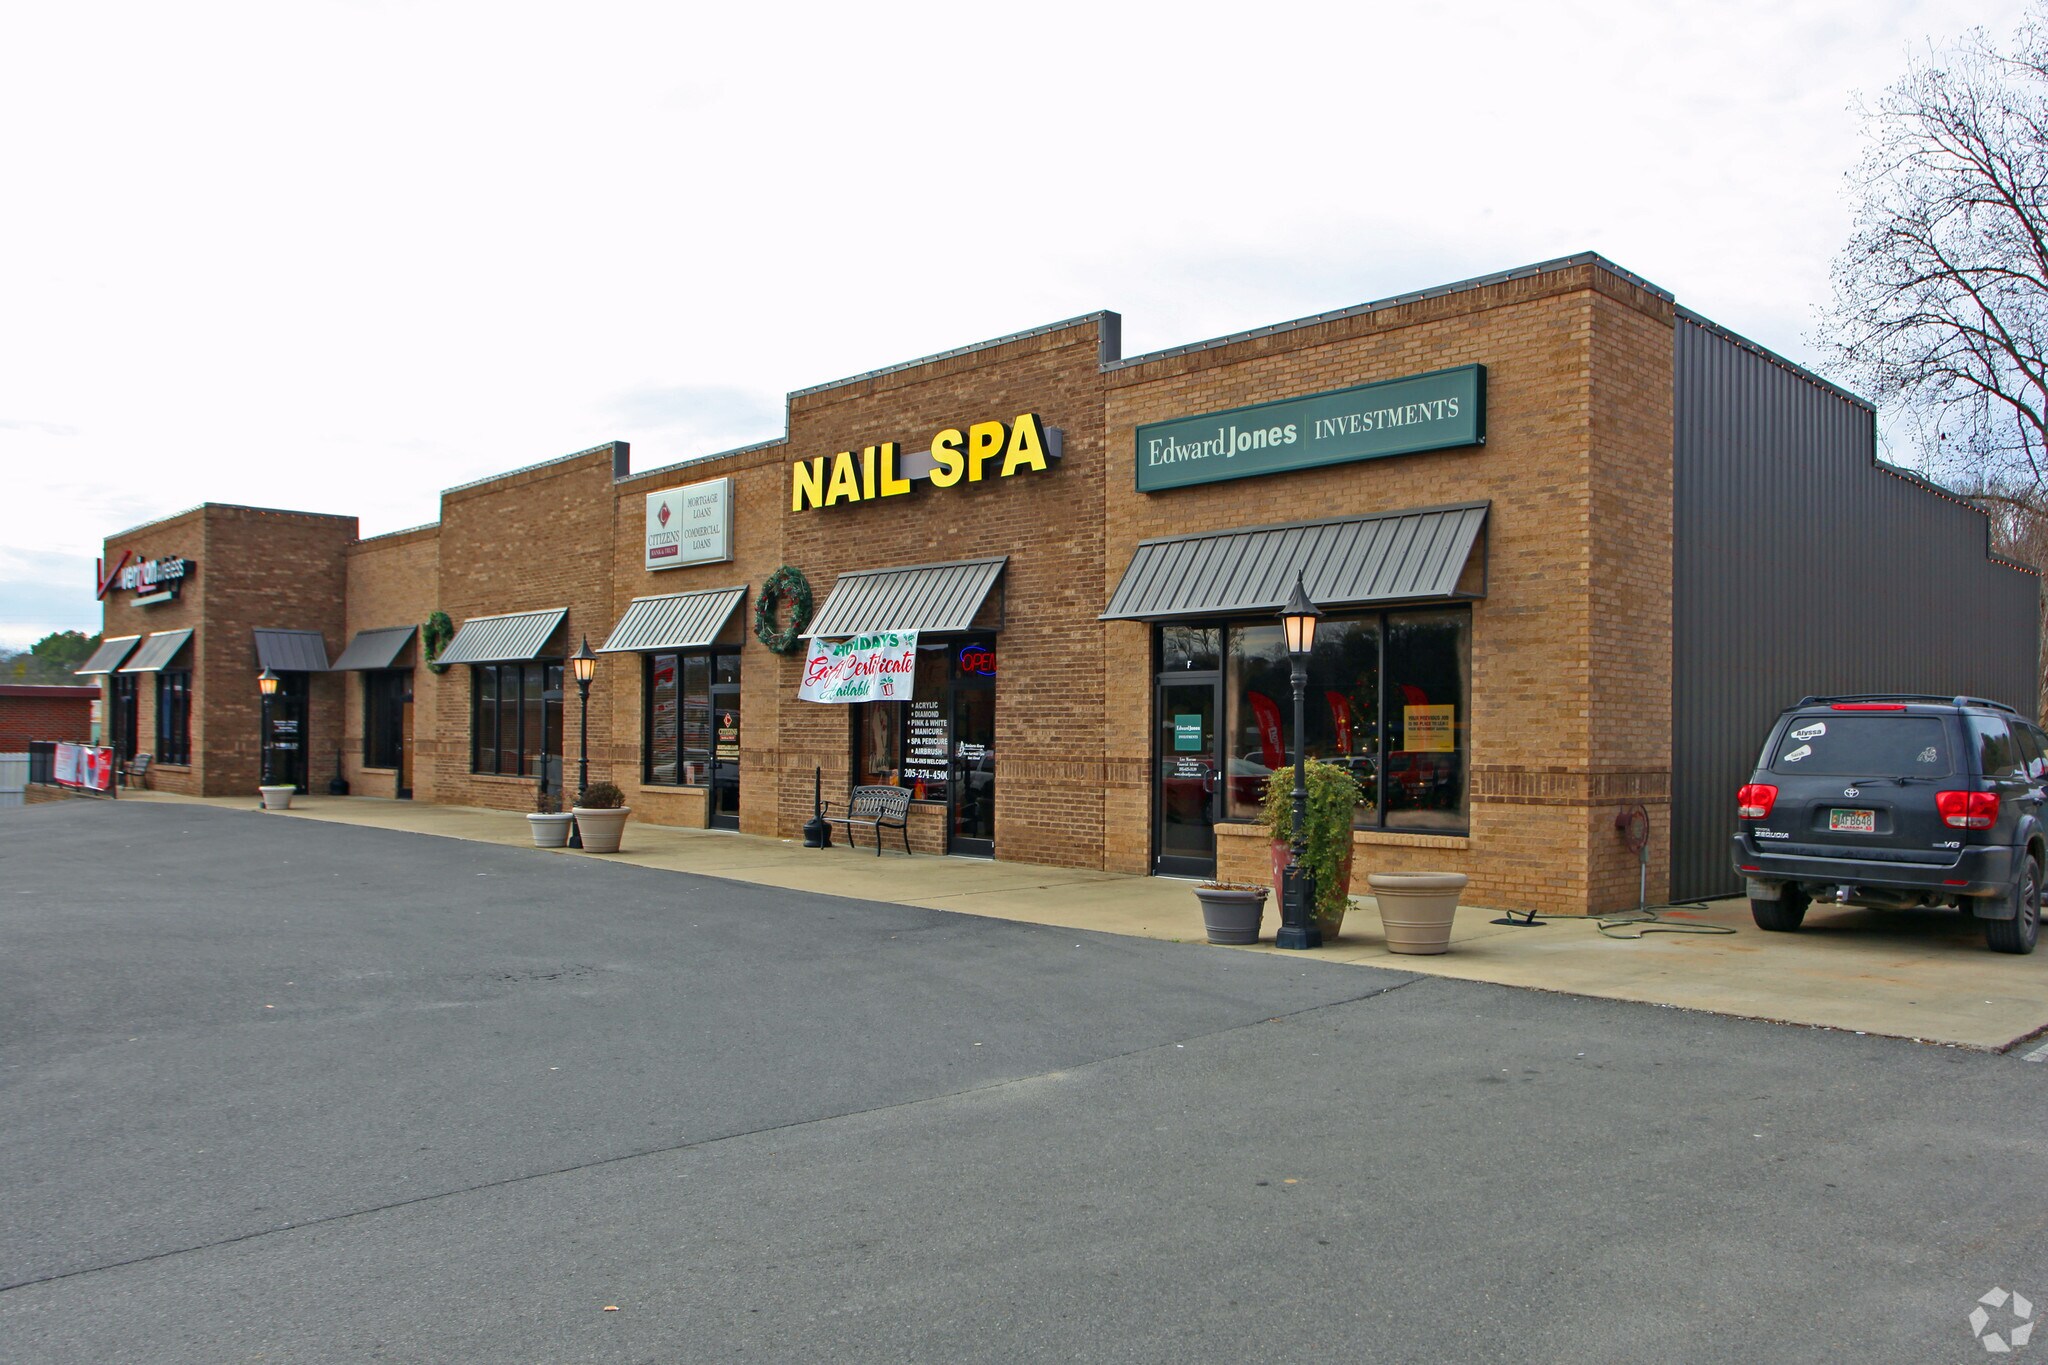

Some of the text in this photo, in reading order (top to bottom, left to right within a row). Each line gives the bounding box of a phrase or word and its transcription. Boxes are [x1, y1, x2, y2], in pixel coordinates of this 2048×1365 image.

[1314, 397, 1460, 440] INVESTMENTS
[1148, 423, 1298, 467] Edward Jones
[792, 413, 1048, 512] NAIL SPA
[687, 493, 718, 508] MORTGAGE
[693, 507, 712, 519] LOANS
[648, 530, 680, 546] CITIZENS
[684, 525, 720, 539] COMMERCIAL
[692, 538, 711, 550] LOANS
[121, 556, 185, 592] verizon wireless
[833, 633, 900, 657] HOIDAYS
[804, 651, 915, 689] Gift Certificate
[962, 653, 997, 671] OPEN
[1187, 660, 1192, 669] F
[915, 748, 943, 756] AIRBRUSH
[1754, 831, 1790, 839] SEQUOIA
